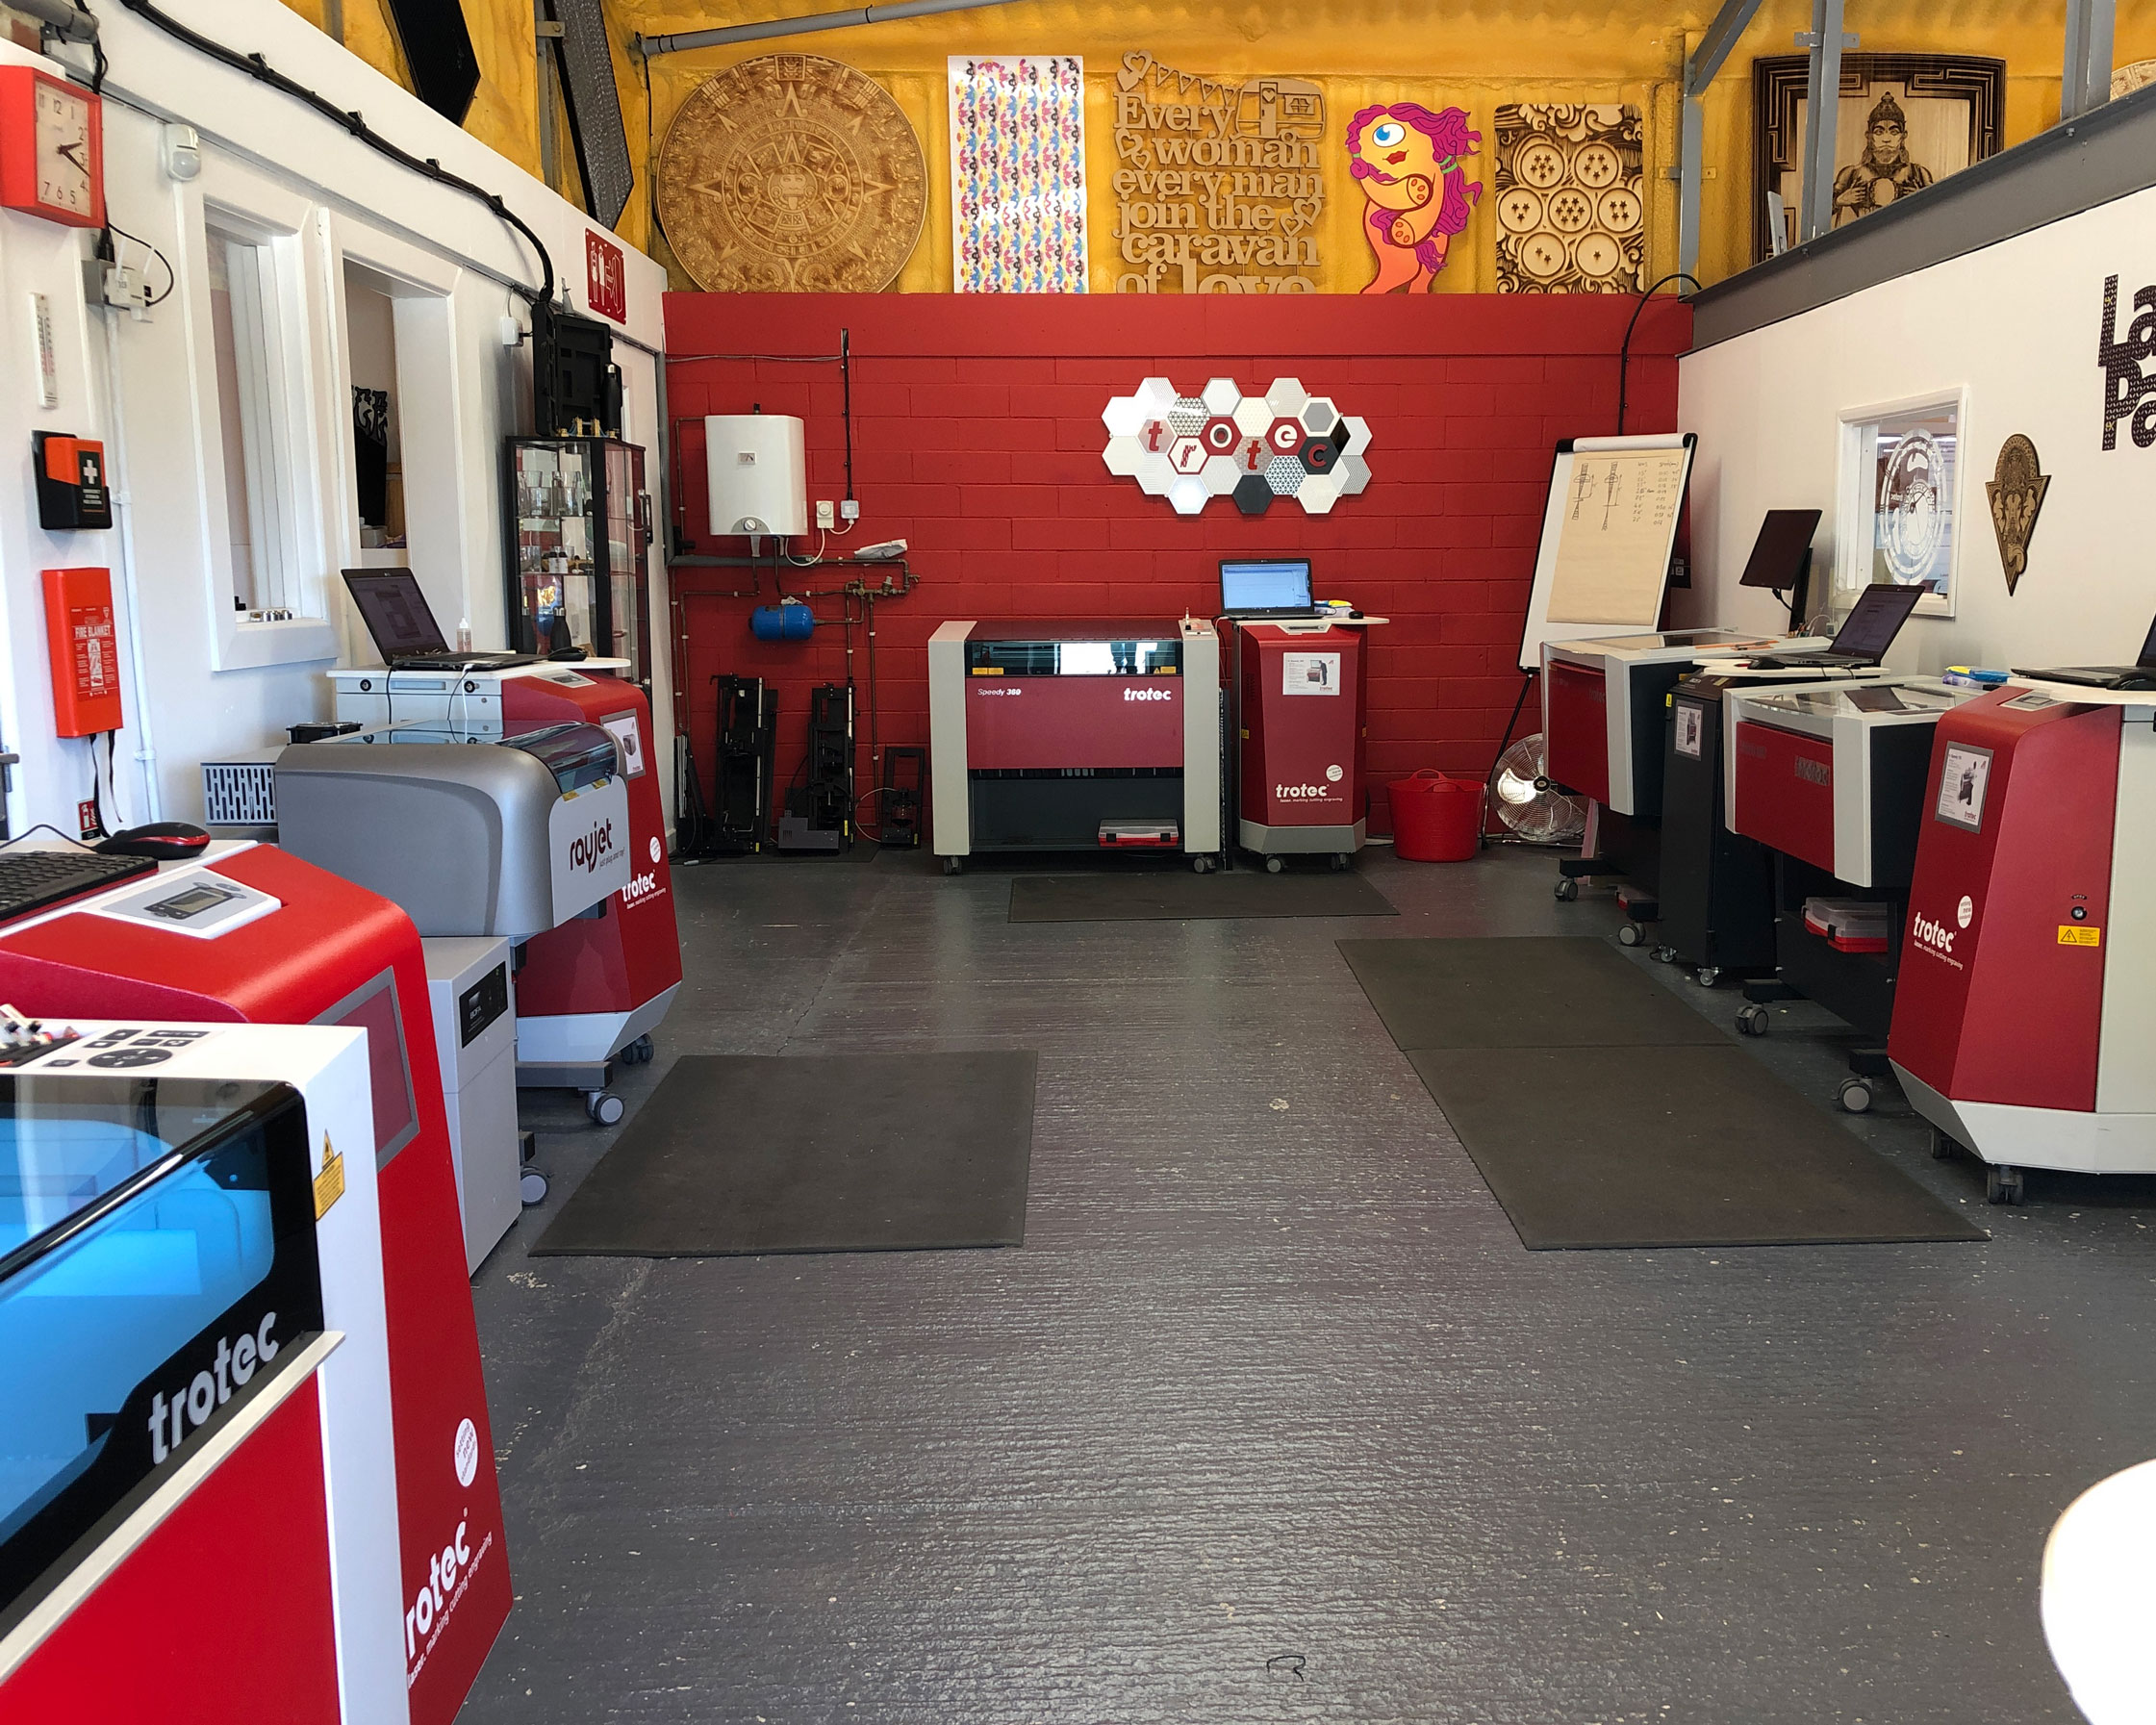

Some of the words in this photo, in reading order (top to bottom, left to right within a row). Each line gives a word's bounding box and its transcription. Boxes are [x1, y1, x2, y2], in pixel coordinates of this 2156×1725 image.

[53, 98, 63, 115] 12
[70, 106, 75, 119] 1
[1113, 91, 1235, 140] Every
[78, 126, 85, 140] 2
[1152, 138, 1321, 168] woman
[43, 181, 50, 196] 7
[57, 186, 63, 200] 6
[70, 190, 76, 205] 5
[1112, 168, 1226, 206] every
[1230, 171, 1325, 198] man
[1112, 192, 1199, 239] join
[1205, 195, 1276, 231] the
[1121, 233, 1321, 266] caravan
[1116, 262, 1167, 294] of
[1148, 420, 1328, 470] trotec
[75, 626, 88, 639] FIRE
[88, 625, 111, 637] BLANKET
[977, 688, 1005, 697] Speedy
[1124, 687, 1172, 701] trotec
[1276, 783, 1328, 798] trotec
[570, 818, 612, 874] rayjet
[621, 873, 656, 902] trotec
[1913, 911, 1955, 953] trotec
[148, 1311, 279, 1464] trotec
[426, 1609, 449, 1656] marking
[449, 1575, 469, 1612] cutting
[468, 1531, 493, 1579] engraving
